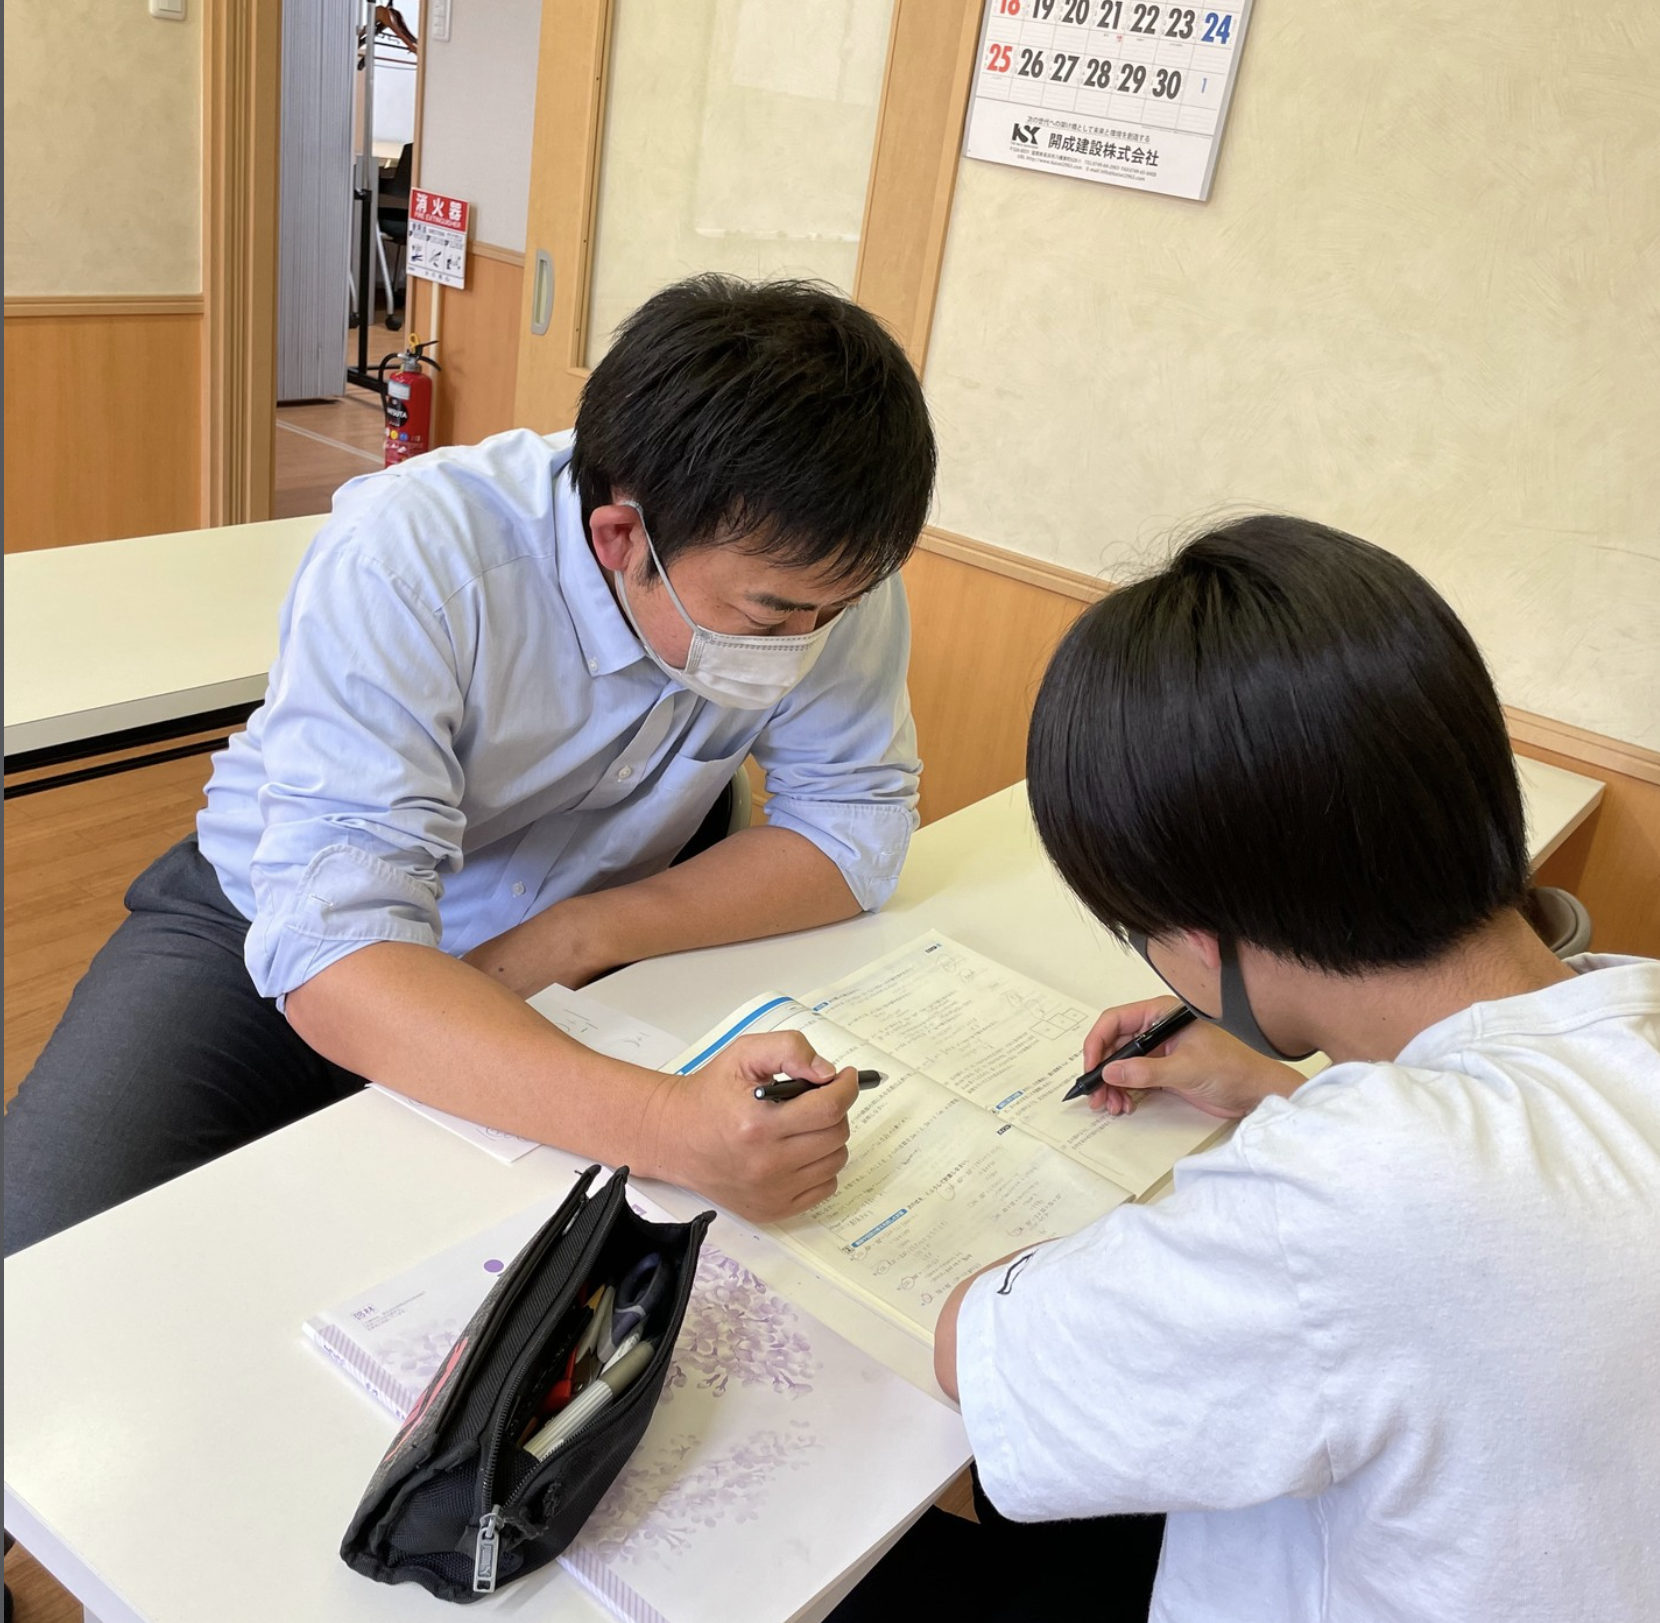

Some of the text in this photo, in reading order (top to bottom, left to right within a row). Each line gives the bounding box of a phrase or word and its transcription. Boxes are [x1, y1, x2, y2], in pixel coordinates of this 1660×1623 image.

[1032, 0, 1052, 20] 19
[1062, 0, 1090, 25] 20
[1096, 1, 1123, 30] 21
[1130, 4, 1160, 35] 22
[1165, 8, 1196, 40] 23
[1201, 12, 1233, 44] 24
[987, 43, 1208, 100] 25 26 27 28 29 30 1
[1048, 132, 1160, 167] 開成建設株式会社
[415, 193, 462, 221] 消火器
